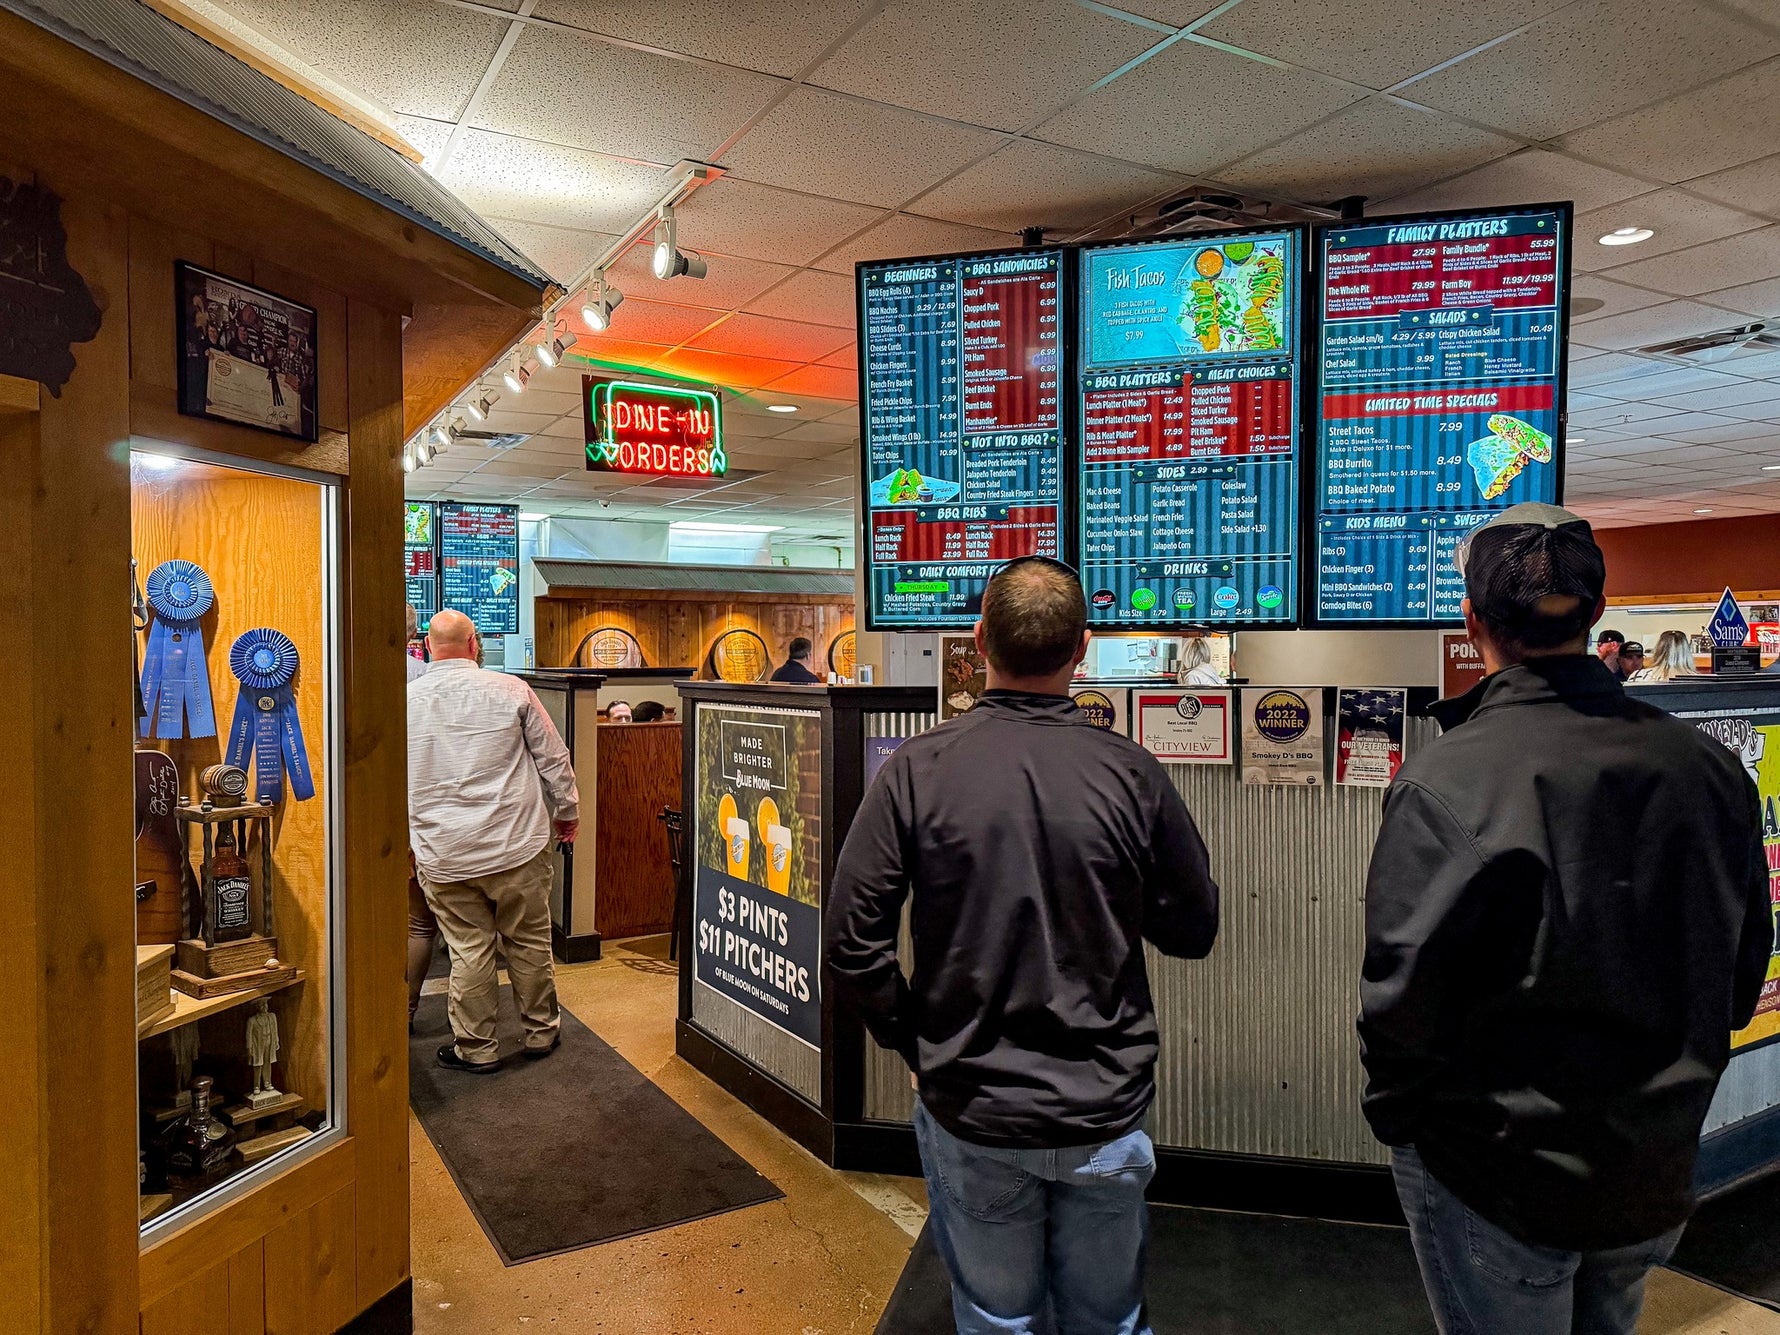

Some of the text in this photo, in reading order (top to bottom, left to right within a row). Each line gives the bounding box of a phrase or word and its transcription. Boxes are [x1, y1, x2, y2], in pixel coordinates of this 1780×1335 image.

[1388, 220, 1507, 243] FAMILY PLATTERS
[1530, 239, 1555, 248] 55.99
[1443, 246, 1463, 255] Family
[972, 257, 1048, 275] BBQ SANDWICHES
[884, 267, 937, 283] BEGINNERS
[1106, 263, 1165, 290] Fish Tacos
[940, 283, 955, 291] 8.99
[1328, 285, 1369, 296] The Whole Pit
[1412, 281, 1435, 290] 79.99
[869, 289, 879, 297] BBQ
[964, 302, 999, 314] Chopped Pork
[1430, 311, 1467, 324] SALADS
[1439, 327, 1500, 339] Crispy Chicken Salad
[1530, 325, 1553, 333] 10.49
[1125, 331, 1144, 341] $7.99
[870, 362, 888, 370] Chicken
[1208, 366, 1276, 380] MEAT CHOICES
[1095, 372, 1171, 388] BBQ PLATTERS
[965, 384, 995, 394] Beef Brisket
[1365, 393, 1498, 411] LIMITED TIME SPECIALS
[615, 401, 709, 434] DINE-IN
[1086, 417, 1104, 425] Dinner
[1105, 416, 1123, 424] Platter
[1164, 412, 1183, 420] 14.99
[1191, 416, 1238, 425] Smoked Sausage
[1329, 425, 1374, 436] Street Tacos
[1438, 422, 1463, 432] 7.99
[972, 433, 1049, 448] NOT INTO BBQ?
[620, 441, 709, 474] ORDERS
[1328, 458, 1372, 468] BBQ Burrito
[1436, 455, 1462, 465] 8.49
[1157, 466, 1185, 478] SIDES
[1328, 483, 1395, 495] BBQ Baked Potato
[1435, 482, 1461, 492] 8.99
[1016, 490, 1034, 498] Fingers
[1241, 496, 1257, 504] Salad
[937, 507, 987, 519] BBQ RIBS
[1346, 515, 1406, 529] KIDS MENU
[920, 566, 988, 577] DAILY COMFORT
[1164, 563, 1208, 575] DRINKS
[1322, 583, 1334, 591] Mini
[1348, 582, 1383, 590] Sandwiches
[1383, 582, 1393, 591] (2)
[885, 594, 905, 602] Chicken
[1321, 601, 1372, 610] Corndog Bites (6)
[1119, 608, 1142, 617] Kids Size
[1715, 619, 1743, 640] Sam's
[950, 643, 968, 656] Soup
[1181, 700, 1198, 715] BEST
[1266, 710, 1297, 718] 2022
[1259, 719, 1304, 728] WINNER
[740, 736, 763, 750] MADE
[1153, 742, 1211, 751] CITYVIEW
[1342, 741, 1400, 752] OUR VETERANS!
[733, 752, 772, 769] BRIGHTER
[1252, 752, 1282, 760] Smokey
[217, 884, 230, 894] JACK
[718, 886, 788, 947] $3 PINTS
[700, 918, 810, 1003] $11 PITCHERS
[715, 967, 790, 1015] OF BLUE MOON ON SATURDAYS
